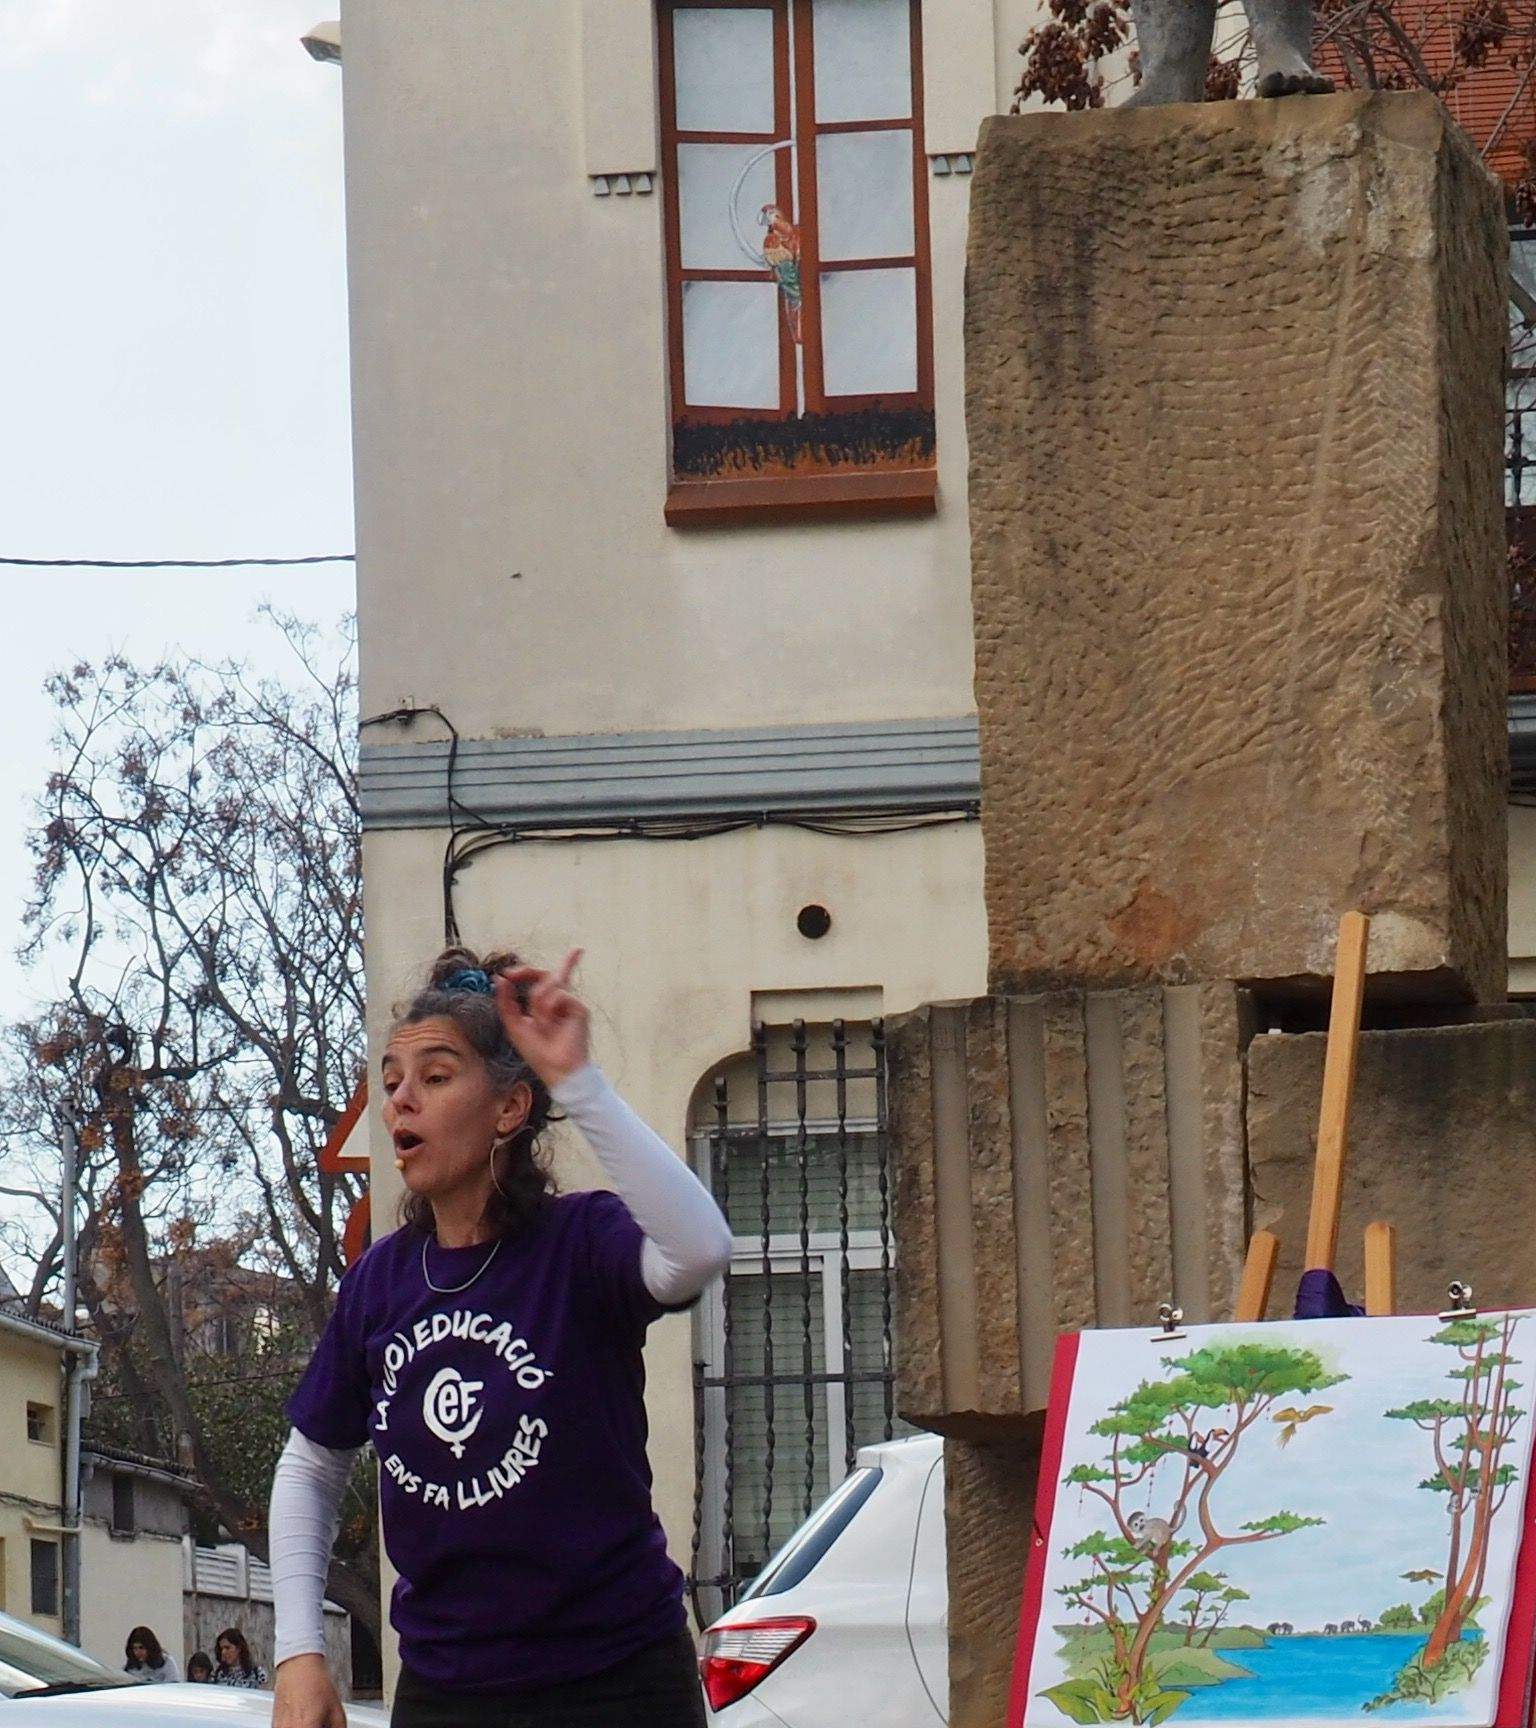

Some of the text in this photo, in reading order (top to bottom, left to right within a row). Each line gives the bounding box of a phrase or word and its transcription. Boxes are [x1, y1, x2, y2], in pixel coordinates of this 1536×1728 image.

[375, 1400, 390, 1430] LA
[384, 1414, 549, 1511] ENS FA LLIURES
